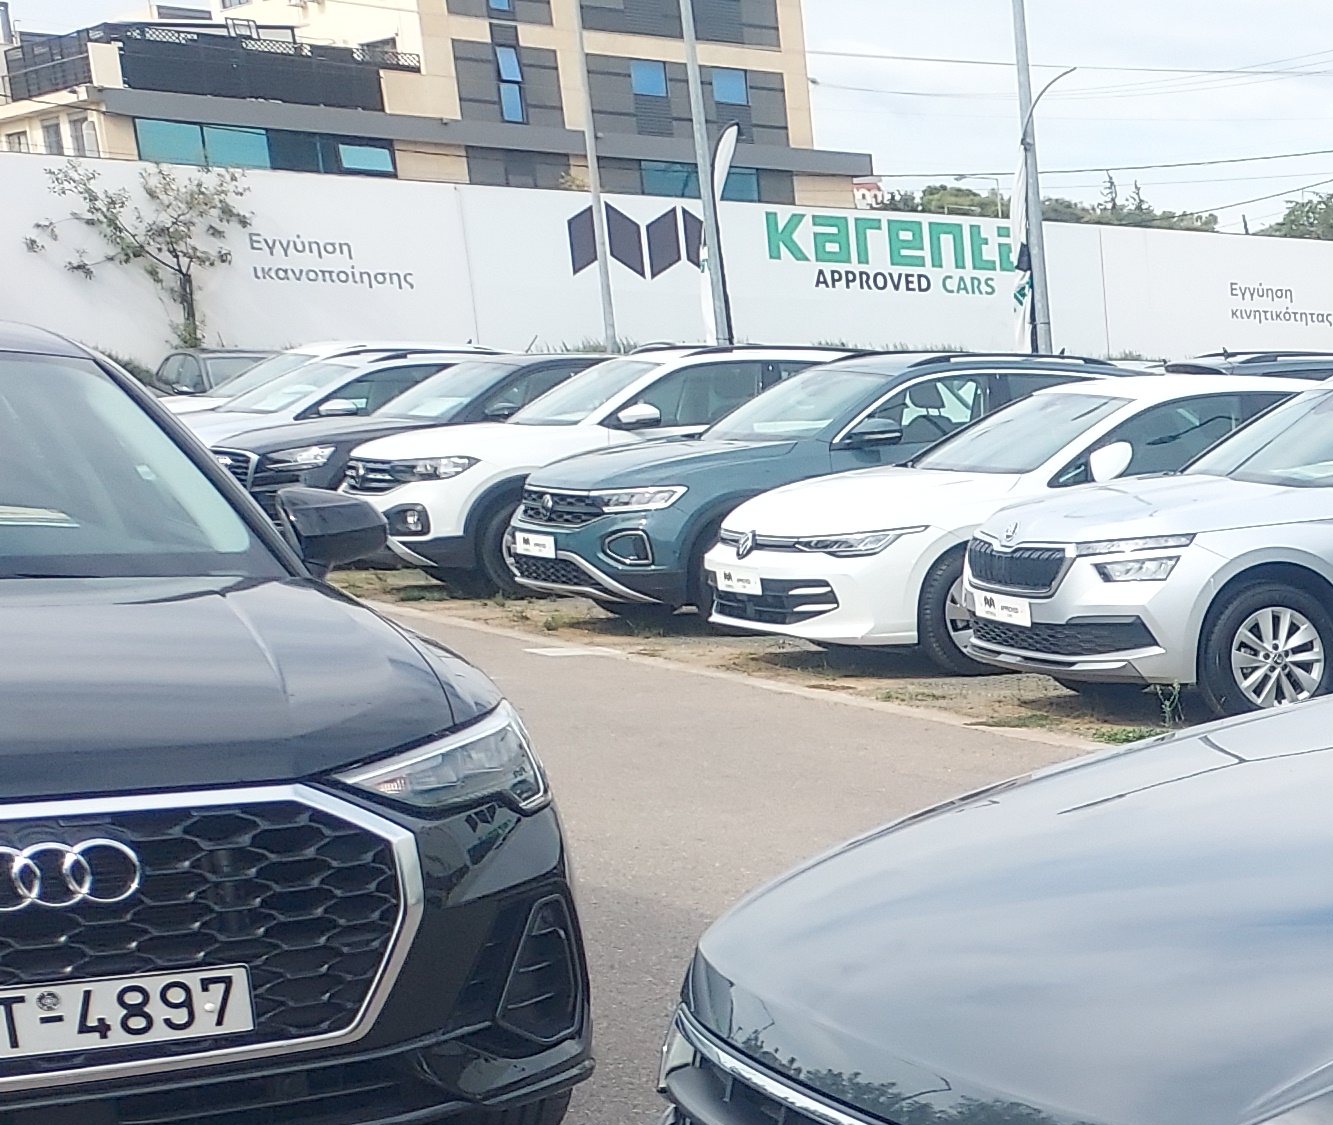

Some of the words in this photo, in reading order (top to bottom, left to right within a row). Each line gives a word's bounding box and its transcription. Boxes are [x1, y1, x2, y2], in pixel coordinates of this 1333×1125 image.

[248, 232, 354, 260] Εγγύηση
[252, 264, 415, 290] ικανοποίησης
[814, 267, 932, 293] APPROVED
[941, 273, 997, 296] CARS
[1229, 281, 1294, 304] Εγγύηση
[1230, 306, 1333, 328] κινητικότητας
